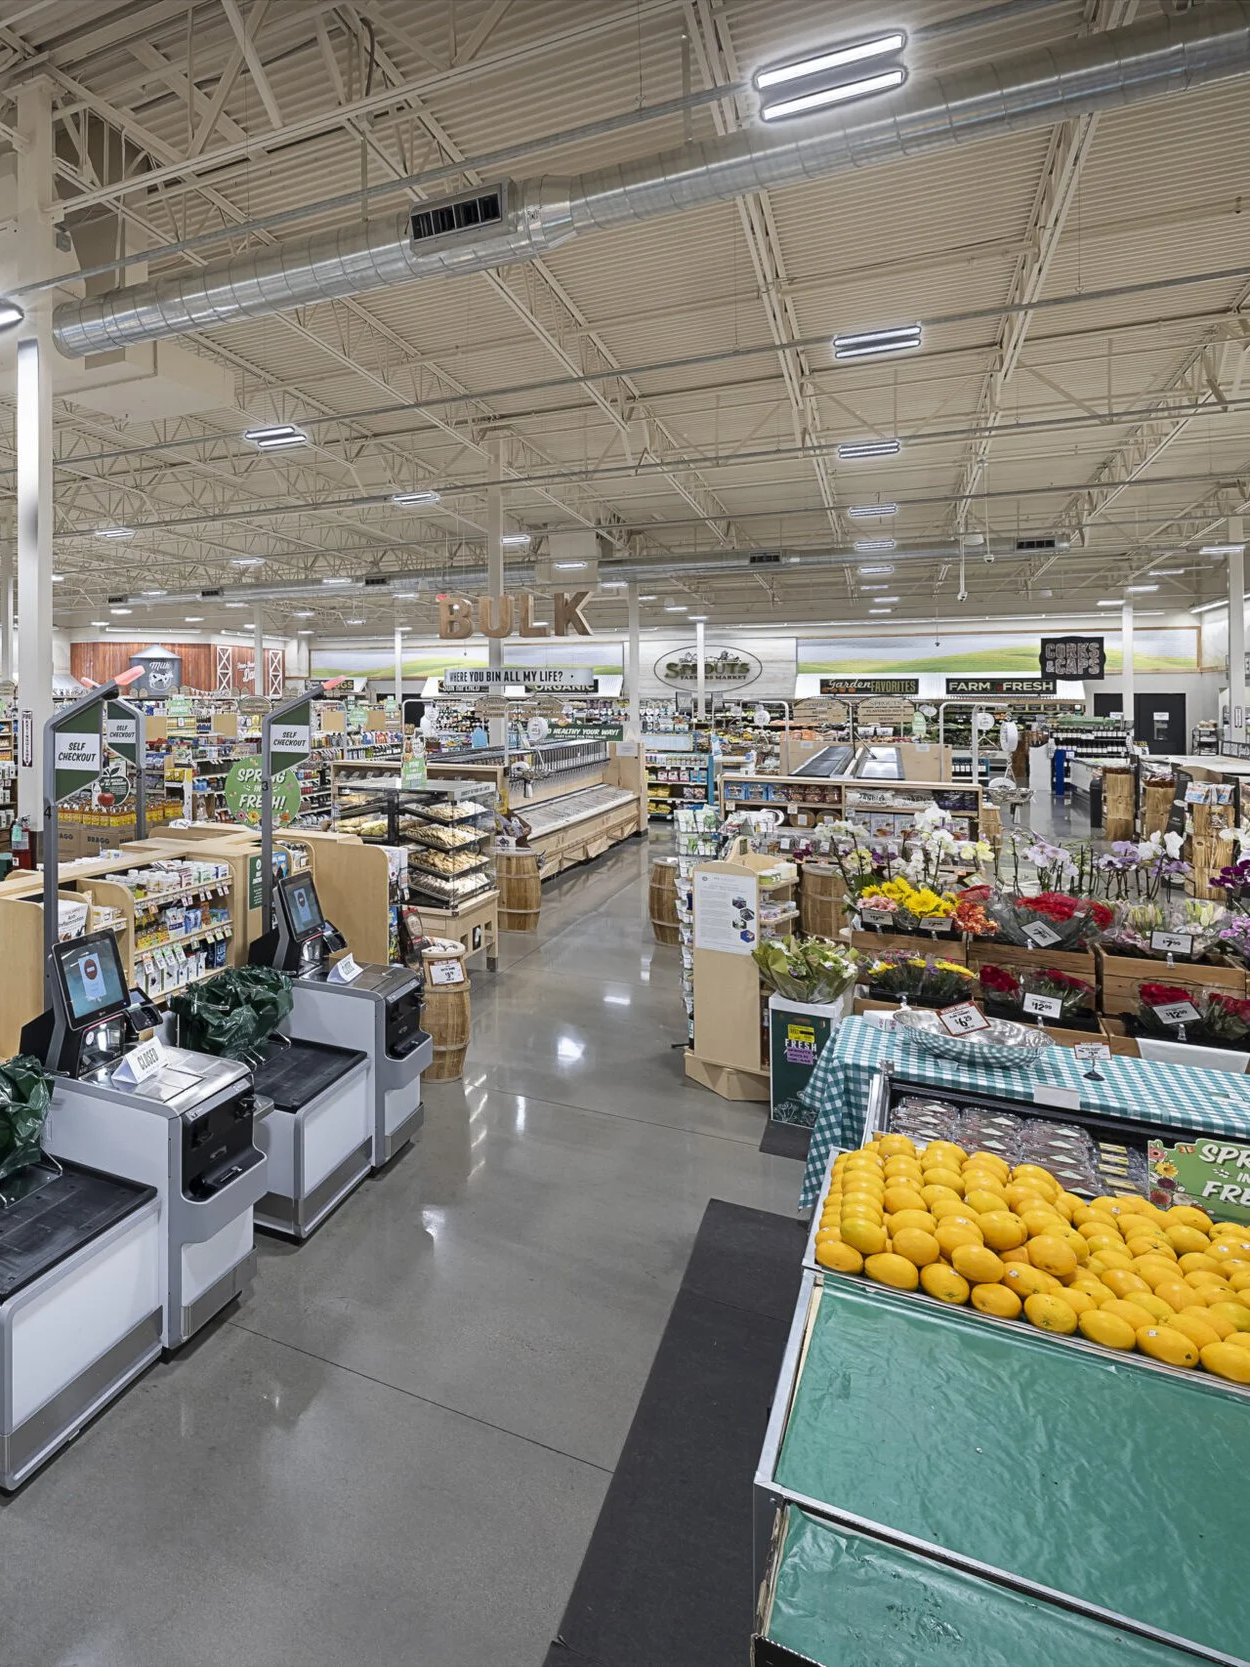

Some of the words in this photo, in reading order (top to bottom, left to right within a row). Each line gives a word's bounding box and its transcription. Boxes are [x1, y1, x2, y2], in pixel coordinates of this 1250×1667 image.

[438, 591, 594, 640] BULK
[1045, 642, 1100, 659] CORKS
[149, 661, 171, 671] Milk
[450, 671, 468, 682] WHERE
[469, 671, 484, 682] YOU
[486, 671, 501, 682] BIN
[504, 671, 521, 682] ALL
[523, 671, 538, 682] MY
[540, 671, 564, 682] LIFE?
[534, 682, 595, 692] ORGANIC
[829, 679, 871, 689] Garden
[870, 680, 916, 693] FAVORITES
[949, 682, 991, 691] FARM
[1002, 682, 1053, 691] FRESH
[282, 731, 297, 739] SELF
[553, 728, 581, 736] HEALTHY
[67, 742, 86, 751] SELF
[272, 739, 307, 747] CHECKOUT
[58, 752, 96, 762] CHECKOUT
[136, 769, 142, 779] 2
[261, 780, 269, 791] 3
[238, 794, 287, 811] FREH!
[43, 805, 52, 820] 4
[785, 1038, 817, 1052] FRESH
